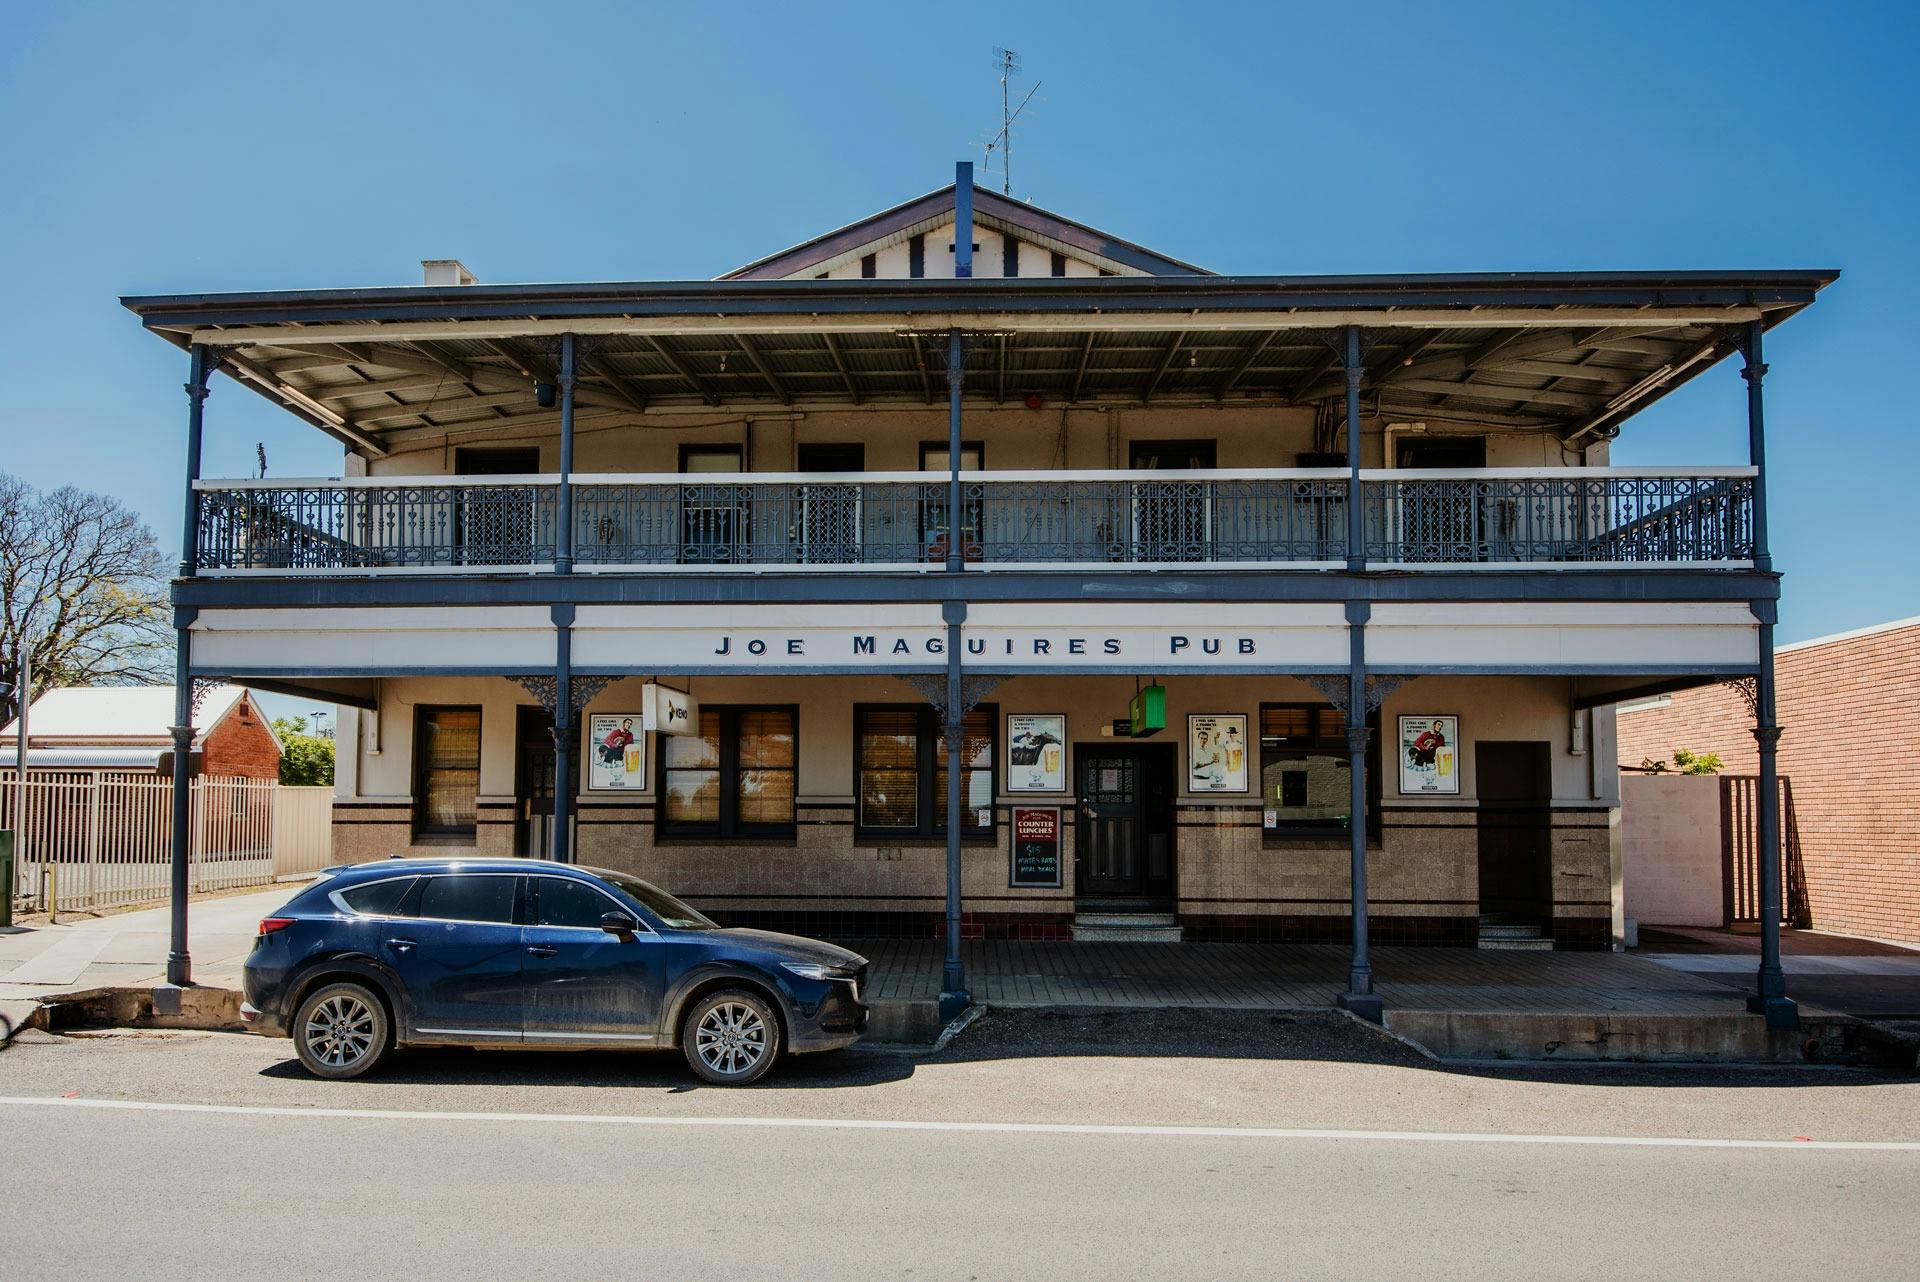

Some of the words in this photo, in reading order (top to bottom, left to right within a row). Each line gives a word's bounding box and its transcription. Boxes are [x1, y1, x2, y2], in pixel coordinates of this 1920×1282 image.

[714, 635, 806, 657] JOE
[853, 635, 1123, 657] MAGUIRES
[1170, 635, 1257, 656] PUB
[676, 707, 687, 720] KENO
[1018, 857, 1040, 865] MATES
